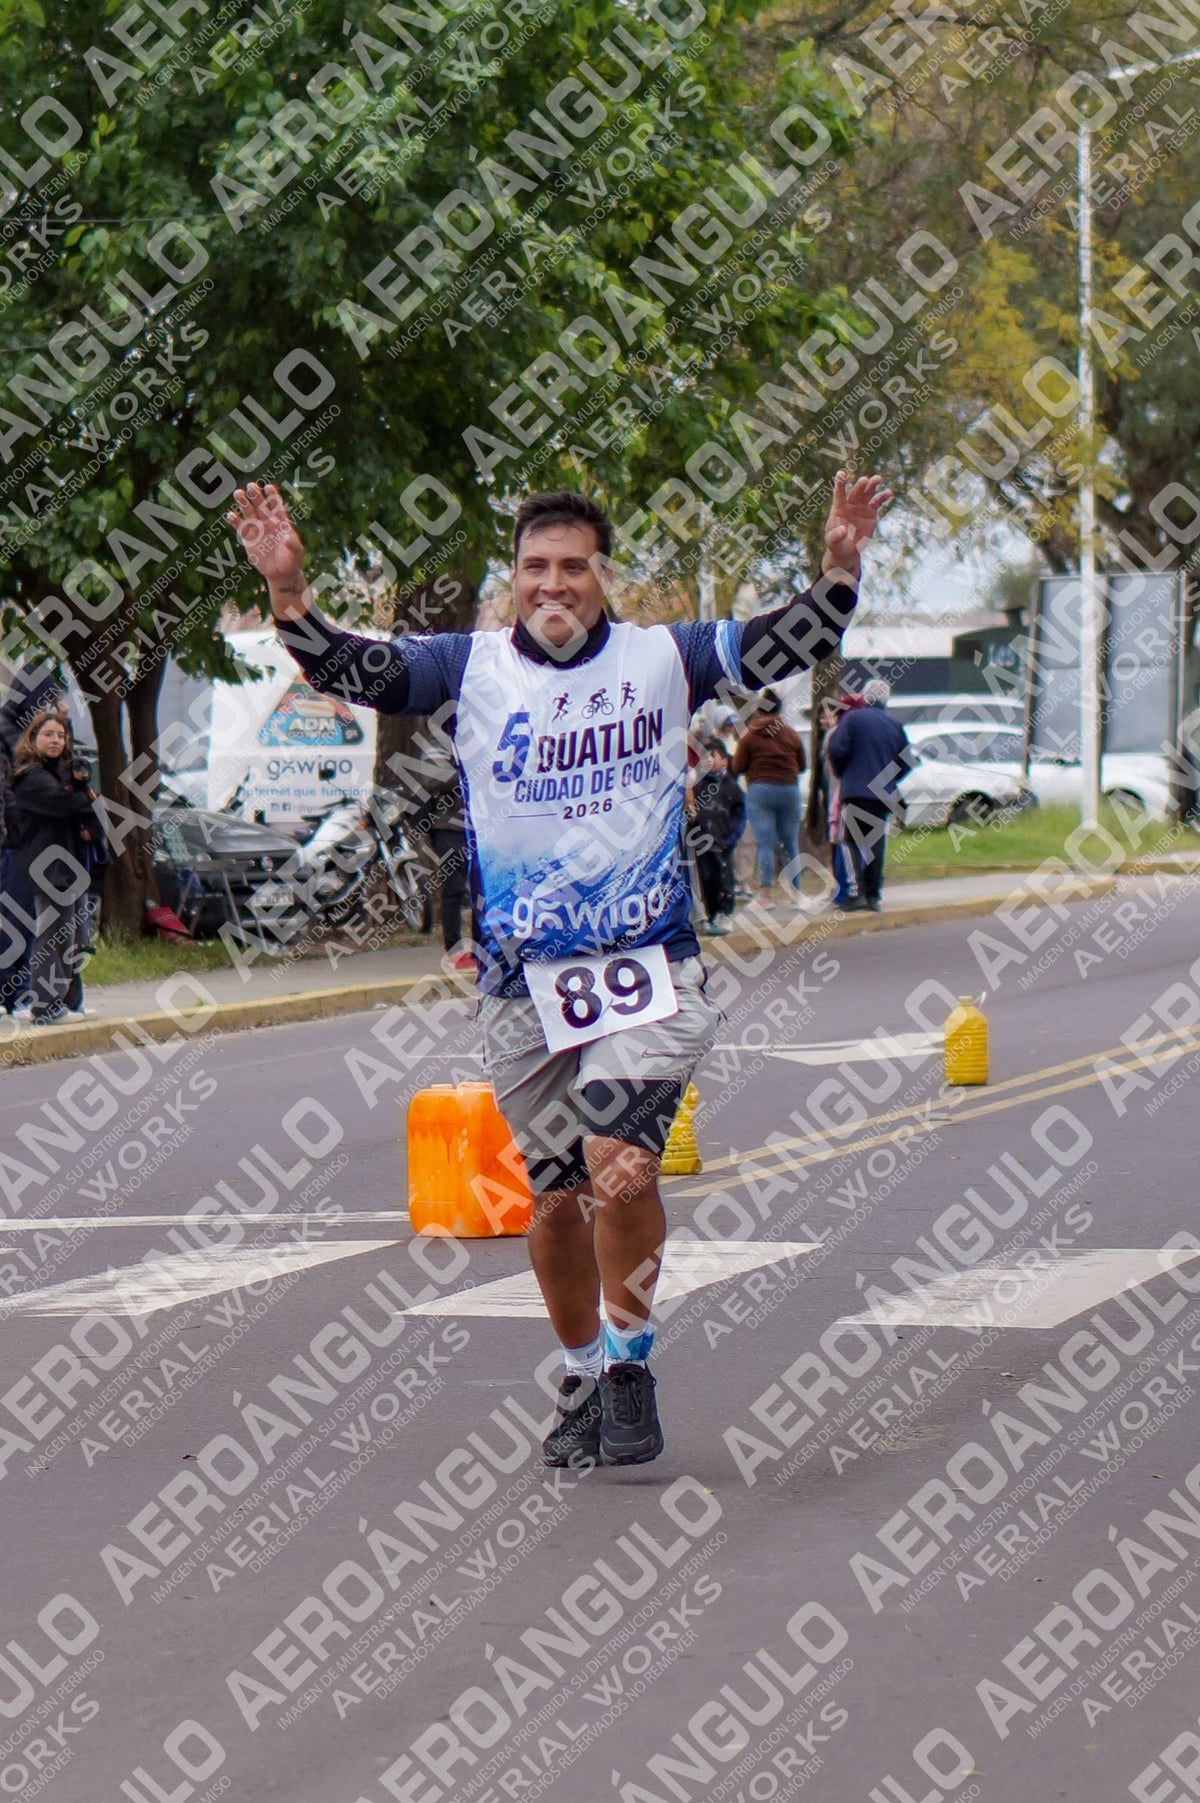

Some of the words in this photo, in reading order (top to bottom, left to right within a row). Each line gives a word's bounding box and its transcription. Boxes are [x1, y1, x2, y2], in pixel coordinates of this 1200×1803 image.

[536, 708, 663, 773] DUATLÓN
[514, 773, 584, 803] CIUDAD
[591, 767, 616, 795] DE
[621, 752, 661, 787] GOYA
[562, 798, 613, 819] 2026
[554, 957, 653, 1029] 89
